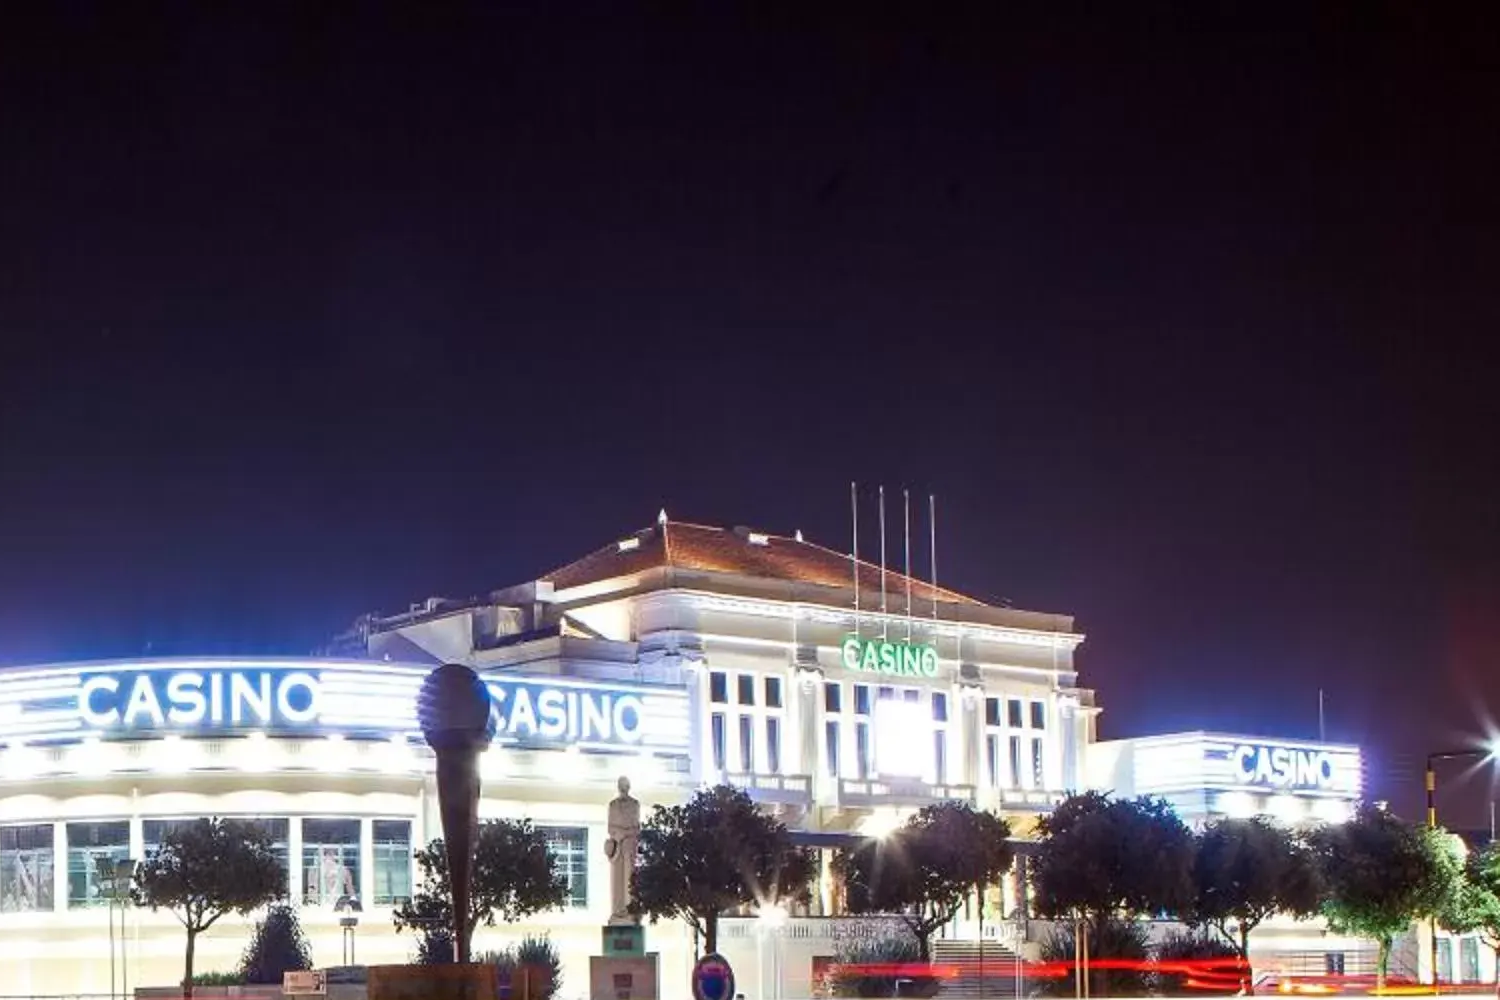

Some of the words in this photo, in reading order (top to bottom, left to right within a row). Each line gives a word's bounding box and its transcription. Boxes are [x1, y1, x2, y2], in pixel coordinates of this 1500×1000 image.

[843, 638, 938, 678] CASINO
[79, 671, 320, 728] CASINO
[1235, 744, 1333, 789] CASINO
